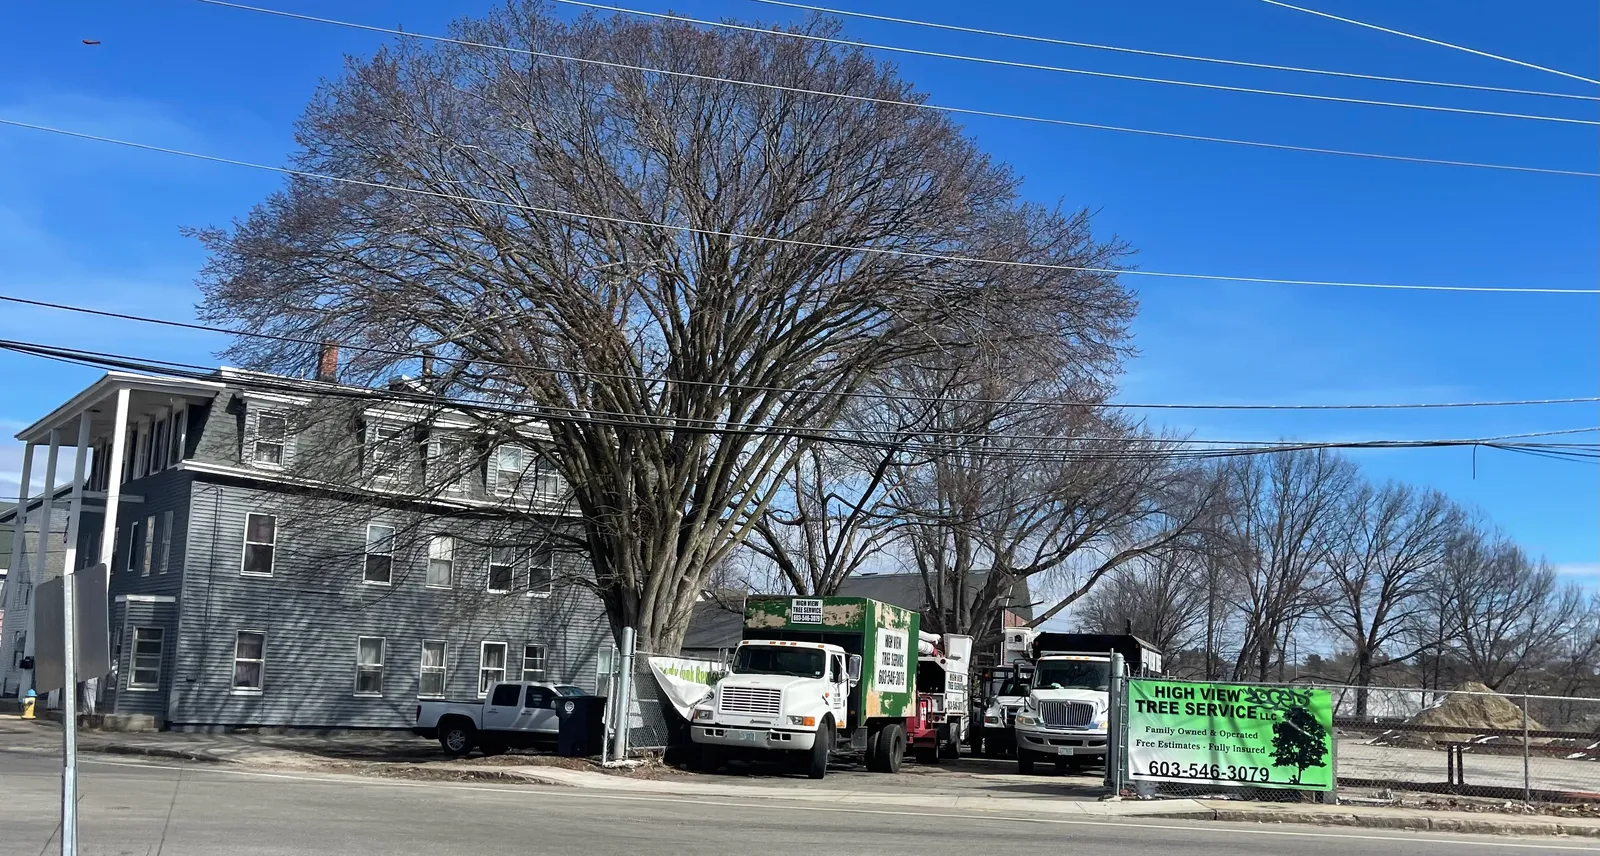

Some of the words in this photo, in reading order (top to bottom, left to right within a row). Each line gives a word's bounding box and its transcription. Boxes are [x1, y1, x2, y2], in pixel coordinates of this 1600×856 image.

[882, 652, 891, 666] TREE
[1154, 685, 1195, 700] HIGH
[1200, 687, 1241, 703] VIEW
[1135, 699, 1180, 715] TREE
[1184, 701, 1257, 719] SERVICE
[1260, 712, 1277, 721] LLC
[1145, 725, 1176, 735] Family
[1178, 727, 1207, 736] Owned
[1219, 730, 1258, 740] Operated
[1136, 739, 1155, 747] Free
[1158, 740, 1201, 750] Estimates
[1209, 743, 1231, 754] Fully
[1233, 745, 1266, 754] Insured
[1148, 760, 1270, 782] 603-546-3079
